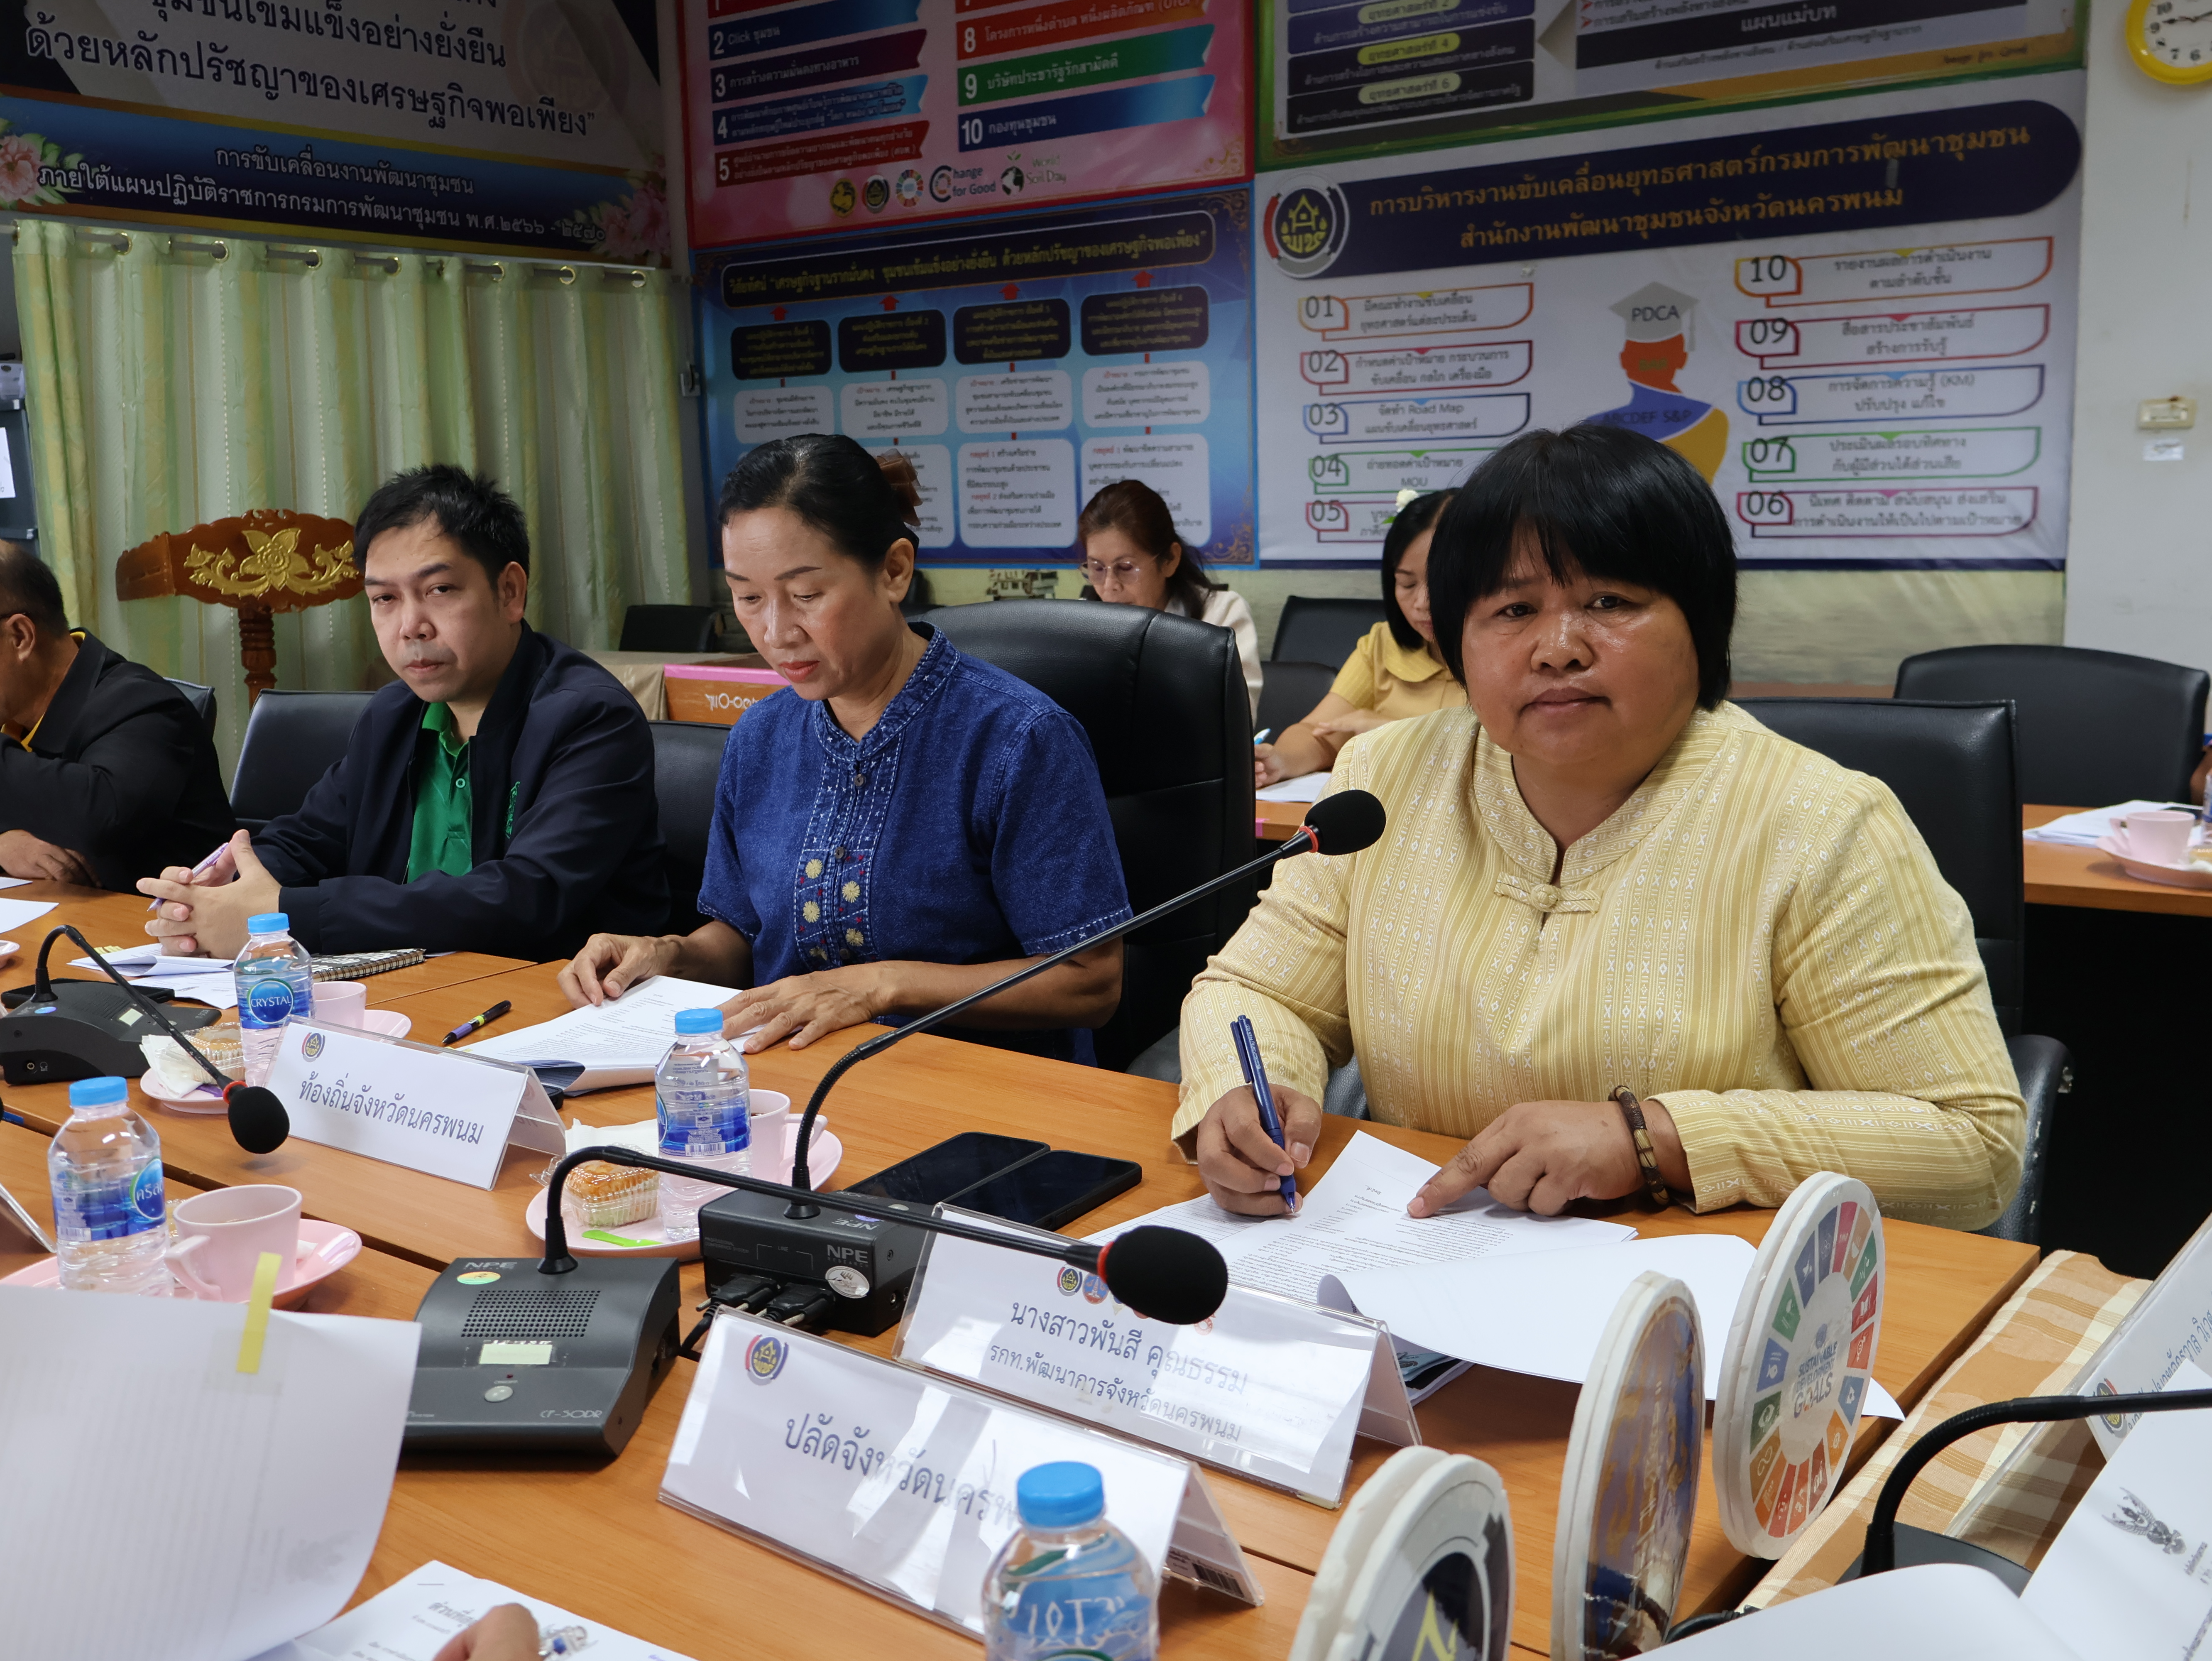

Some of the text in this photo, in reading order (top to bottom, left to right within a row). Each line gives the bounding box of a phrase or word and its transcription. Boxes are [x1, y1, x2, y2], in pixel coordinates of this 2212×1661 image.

[1741, 3, 1837, 32] แผนแม่บท
[713, 31, 724, 54] 2
[964, 27, 976, 53] 8
[2171, 48, 2179, 59] 7
[2190, 49, 2201, 61] 6
[715, 73, 726, 97] 3
[964, 73, 977, 98] 9
[717, 116, 728, 139] 4
[961, 118, 983, 145] 10
[215, 145, 474, 196] การขับเคลื่อนงานพัฒนาชุมชน
[719, 158, 729, 181] 5
[1370, 125, 2030, 216] การบริหารงานขับเคลื่อนยุทธศาสตร์กรมการพัฒนาชุมชน
[969, 182, 995, 195] Good
[1461, 187, 1903, 249] สำนักงานพัฒนาชุมชนจังหวัดนครพนม
[1751, 255, 1786, 282] 10
[1306, 295, 1334, 318] 01
[1632, 305, 1680, 322] PDCA
[1750, 318, 1788, 344] 09
[1309, 350, 1338, 372] 02
[1747, 376, 1785, 402] 08
[1309, 403, 1338, 426] 03
[1409, 404, 1436, 414] Road
[1439, 403, 1464, 414] Map
[1750, 437, 1788, 463] 07
[1312, 456, 1341, 477] 04
[1401, 478, 1428, 487] MOU
[1312, 500, 1340, 522] 05
[1747, 490, 1784, 515] 06
[251, 996, 291, 1008] CRYSTAL
[299, 1071, 484, 1145] ท้องถิ่นจังหวัดนครพนม
[827, 1244, 869, 1264] NPE
[1010, 1300, 1248, 1396] นางสาวพันสี คุณธรรม
[989, 1342, 1241, 1444] รกท.พัฒนาการจังหวัดนครพนม
[1794, 1371, 1833, 1419] GOALS
